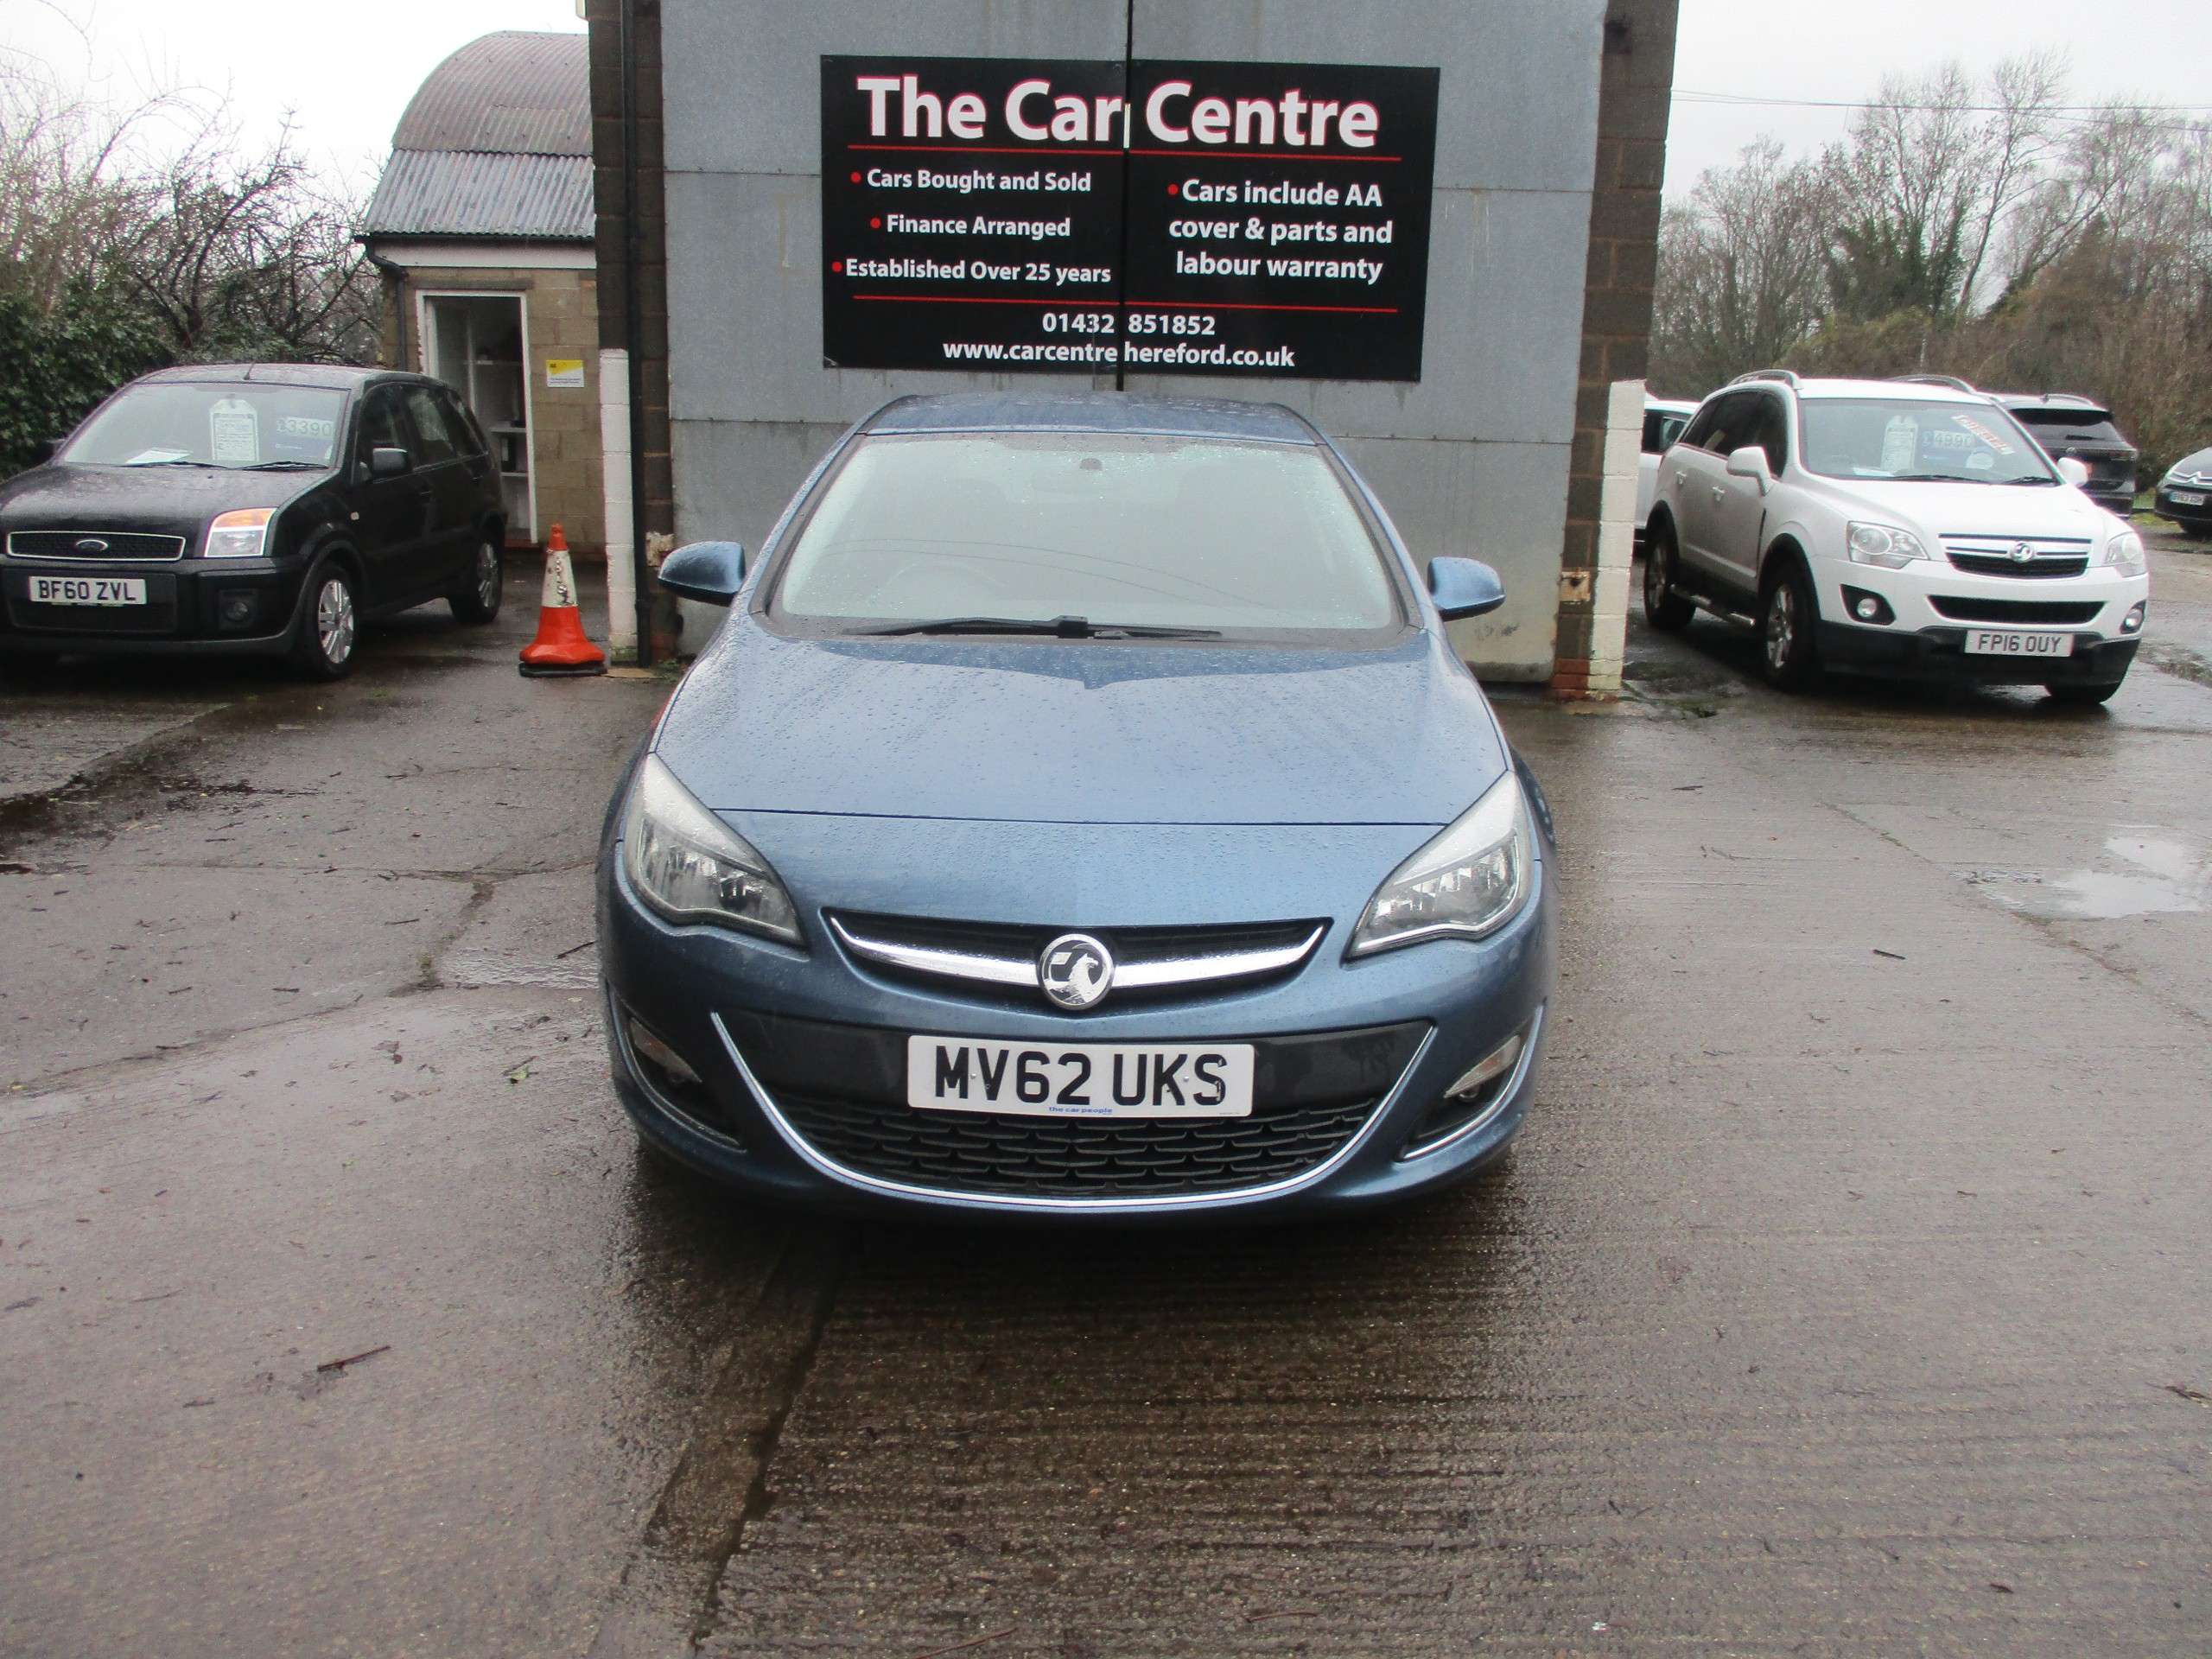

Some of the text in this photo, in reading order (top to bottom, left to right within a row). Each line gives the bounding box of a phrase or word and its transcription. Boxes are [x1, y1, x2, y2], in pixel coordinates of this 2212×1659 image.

[857, 75, 1379, 148] The Car Centre
[867, 168, 1091, 194] Cars Bought and Sold
[1182, 179, 1382, 207] Cars include AA
[887, 213, 1071, 241] Finance Arranged
[1169, 217, 1393, 246] cover & parts and
[846, 258, 1111, 287] Established Over 25 years
[1176, 251, 1383, 285] labour warranty
[1042, 312, 1216, 335] 01432 851852
[38, 580, 136, 601] BF60 ZVL
[1978, 633, 2062, 653] FP16 OUY
[935, 1045, 1228, 1107] MV62 UKS
